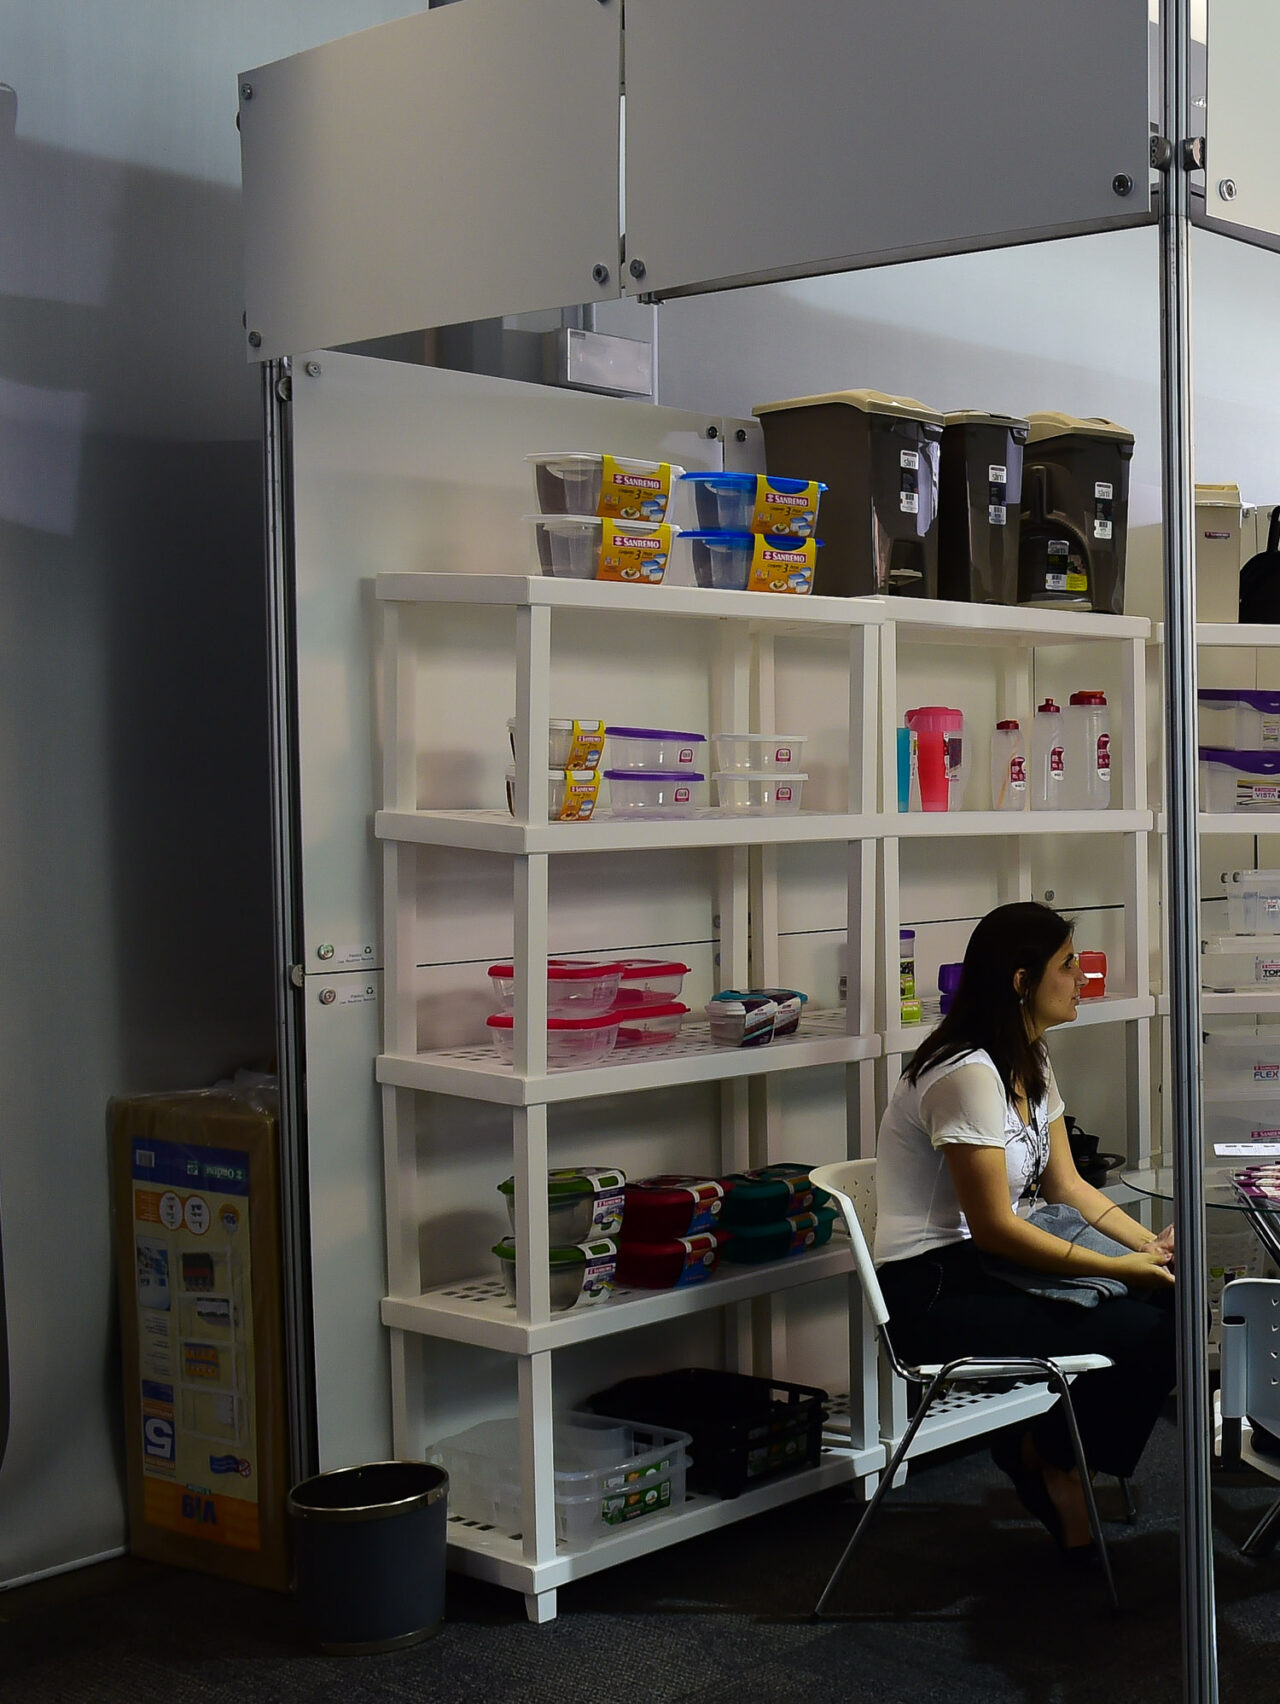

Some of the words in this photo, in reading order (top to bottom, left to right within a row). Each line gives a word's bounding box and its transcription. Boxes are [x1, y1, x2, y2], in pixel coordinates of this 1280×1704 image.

[624, 476, 660, 489] SANREMO
[774, 495, 808, 506] SANREMO
[623, 537, 660, 549] SANREMO
[772, 551, 805, 563] SANREMO
[1253, 1070, 1280, 1079] FLEX
[144, 1417, 173, 1460] 5
